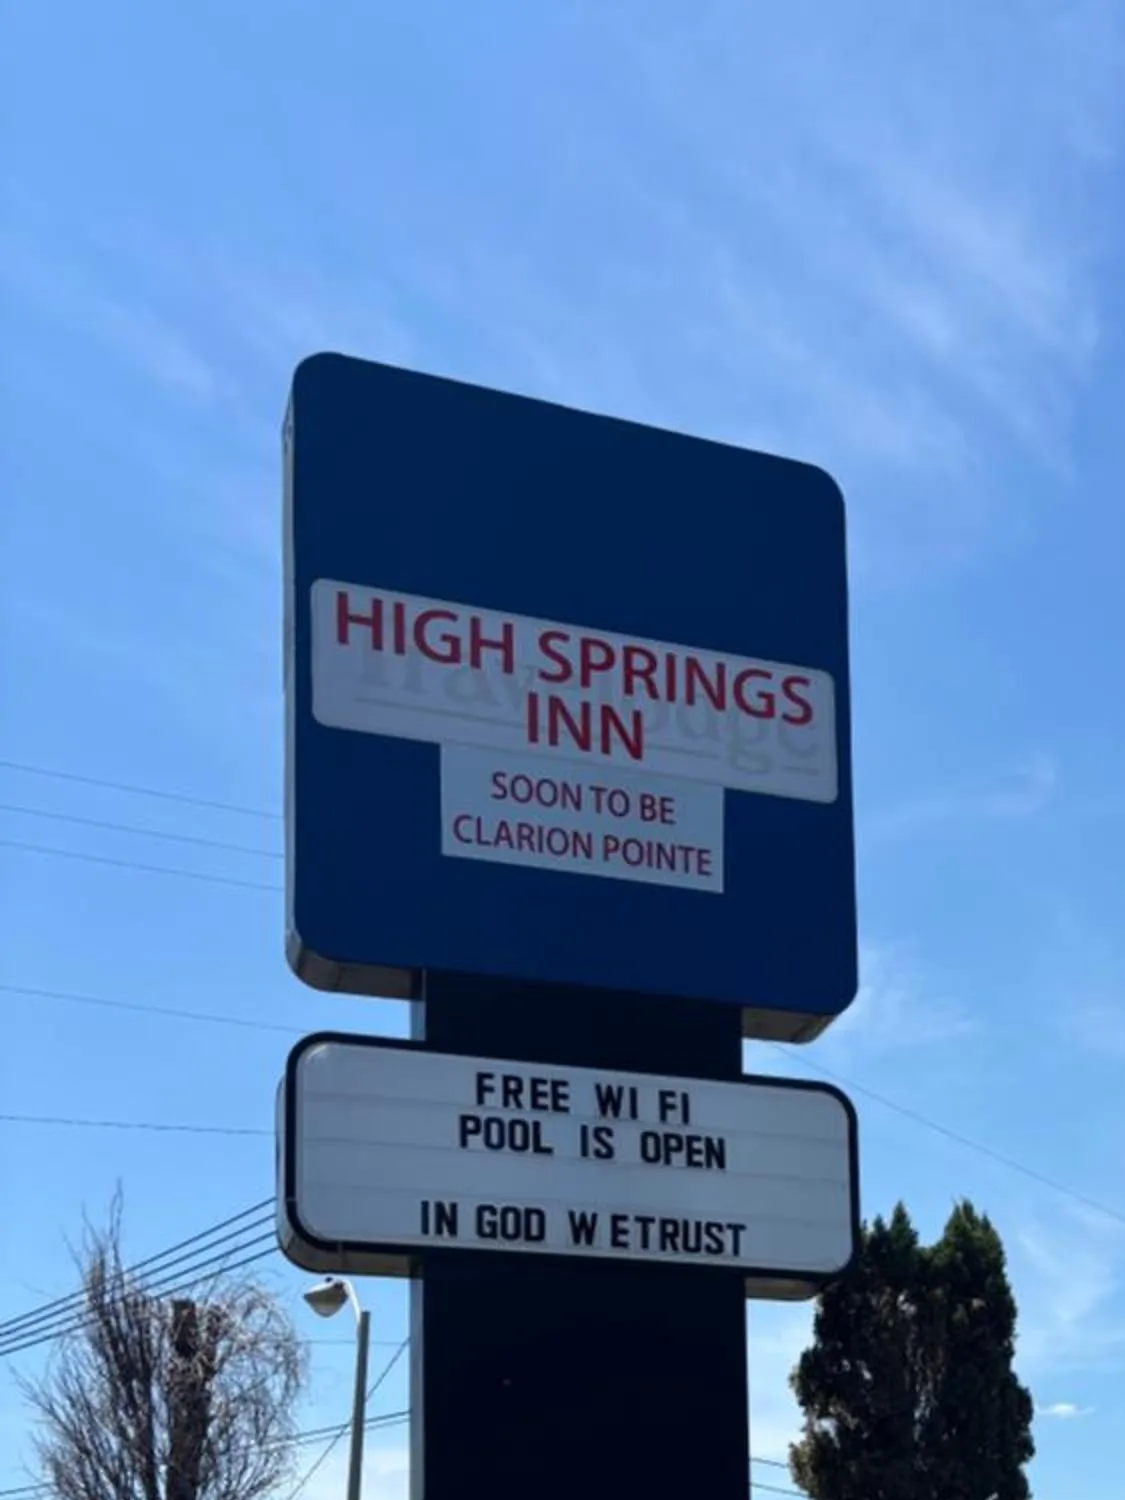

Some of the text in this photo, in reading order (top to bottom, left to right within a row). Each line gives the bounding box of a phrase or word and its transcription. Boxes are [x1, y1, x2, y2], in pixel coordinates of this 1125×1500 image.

[336, 591, 514, 674] HIGH
[538, 630, 815, 725] SPRINGS
[526, 691, 643, 760] INN
[491, 772, 676, 825] SOON TO BE
[452, 814, 712, 876] CLARION POINTE
[476, 1072, 690, 1125] FREE WI FI
[459, 1114, 726, 1170] POOL IS OPEN
[421, 1200, 458, 1237] IN
[475, 1204, 546, 1242] GOD
